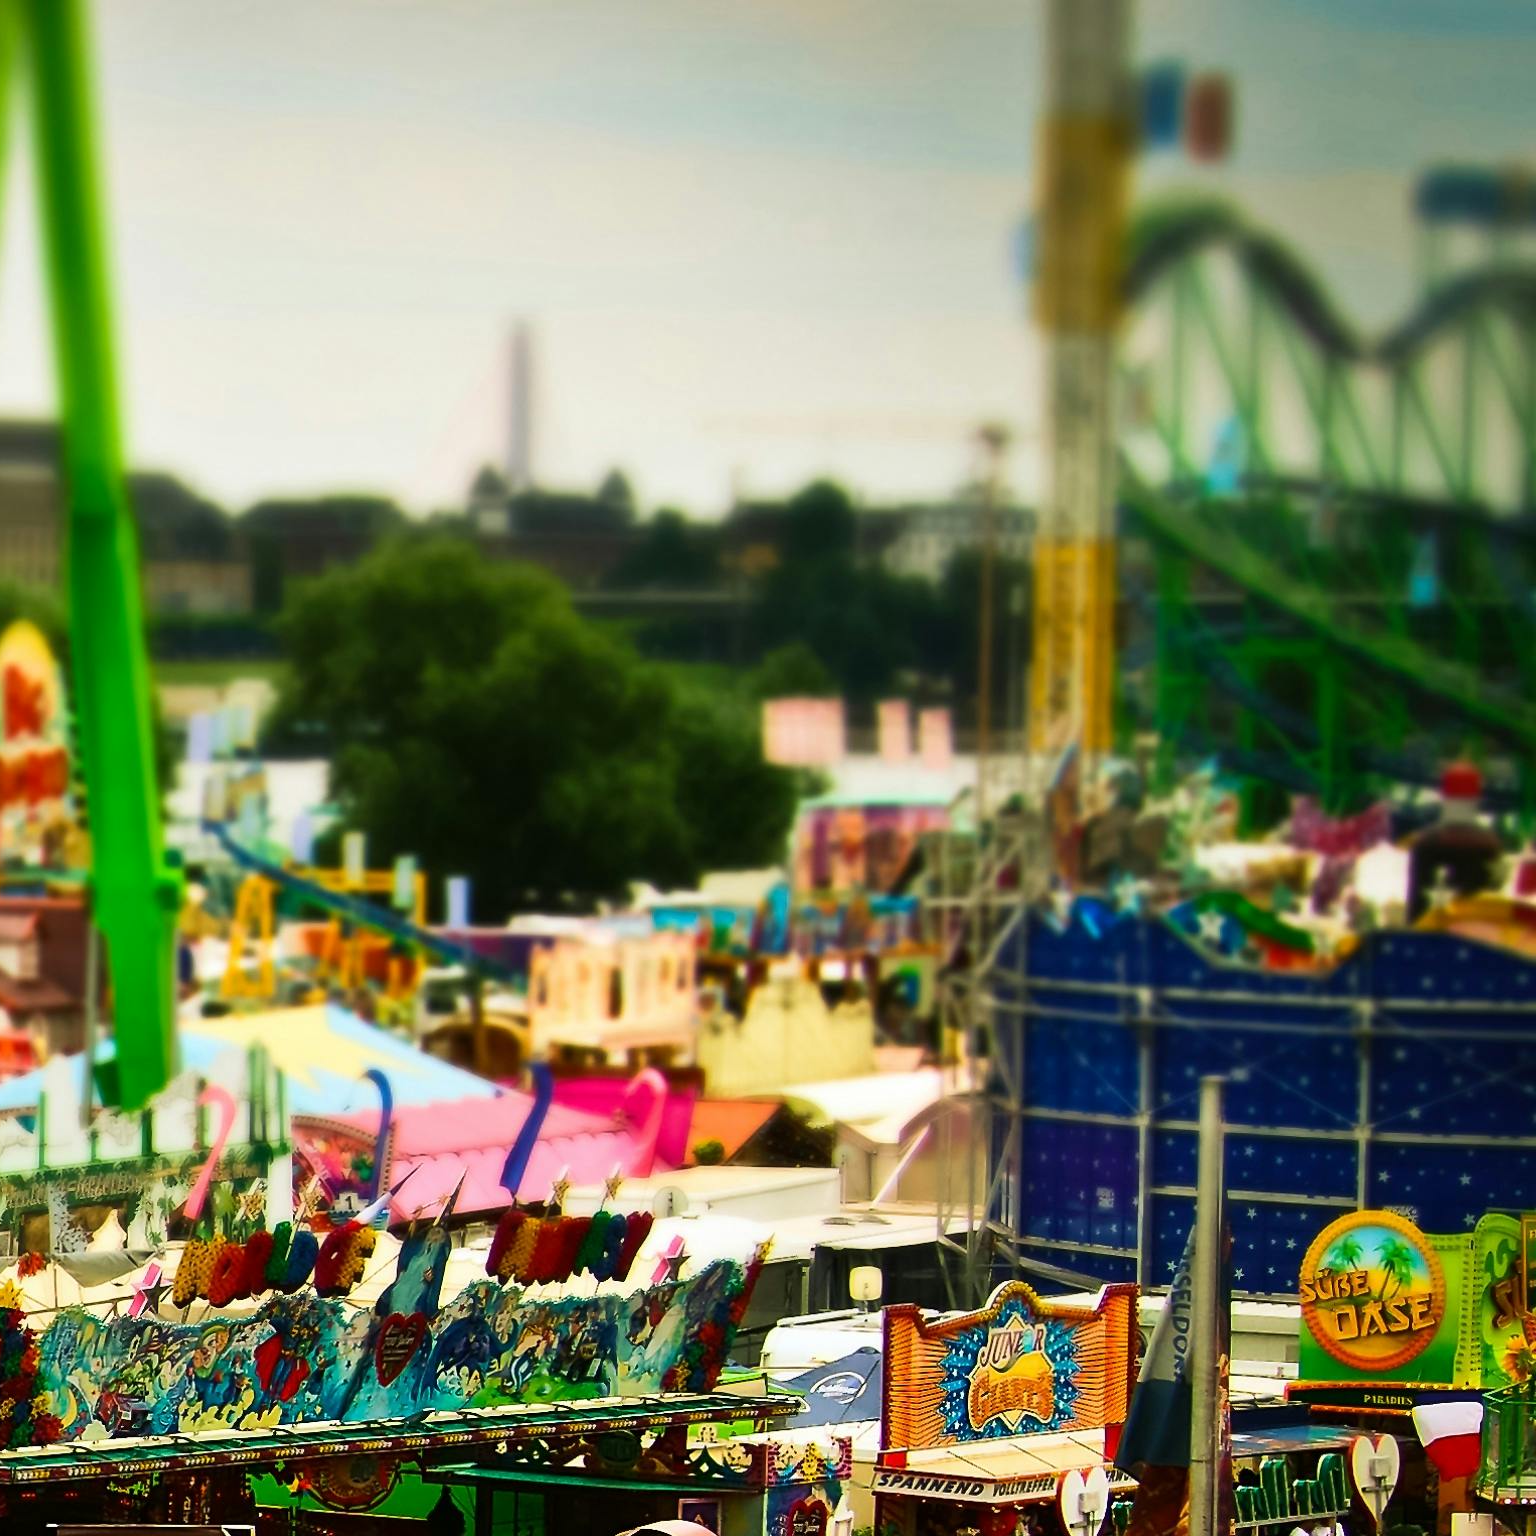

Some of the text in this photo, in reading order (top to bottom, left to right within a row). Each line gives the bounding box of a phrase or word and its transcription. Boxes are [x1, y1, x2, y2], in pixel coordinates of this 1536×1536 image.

[1334, 1292, 1436, 1341] OASE
[877, 1473, 1055, 1498] SPANNEND VOLLTREFFER
